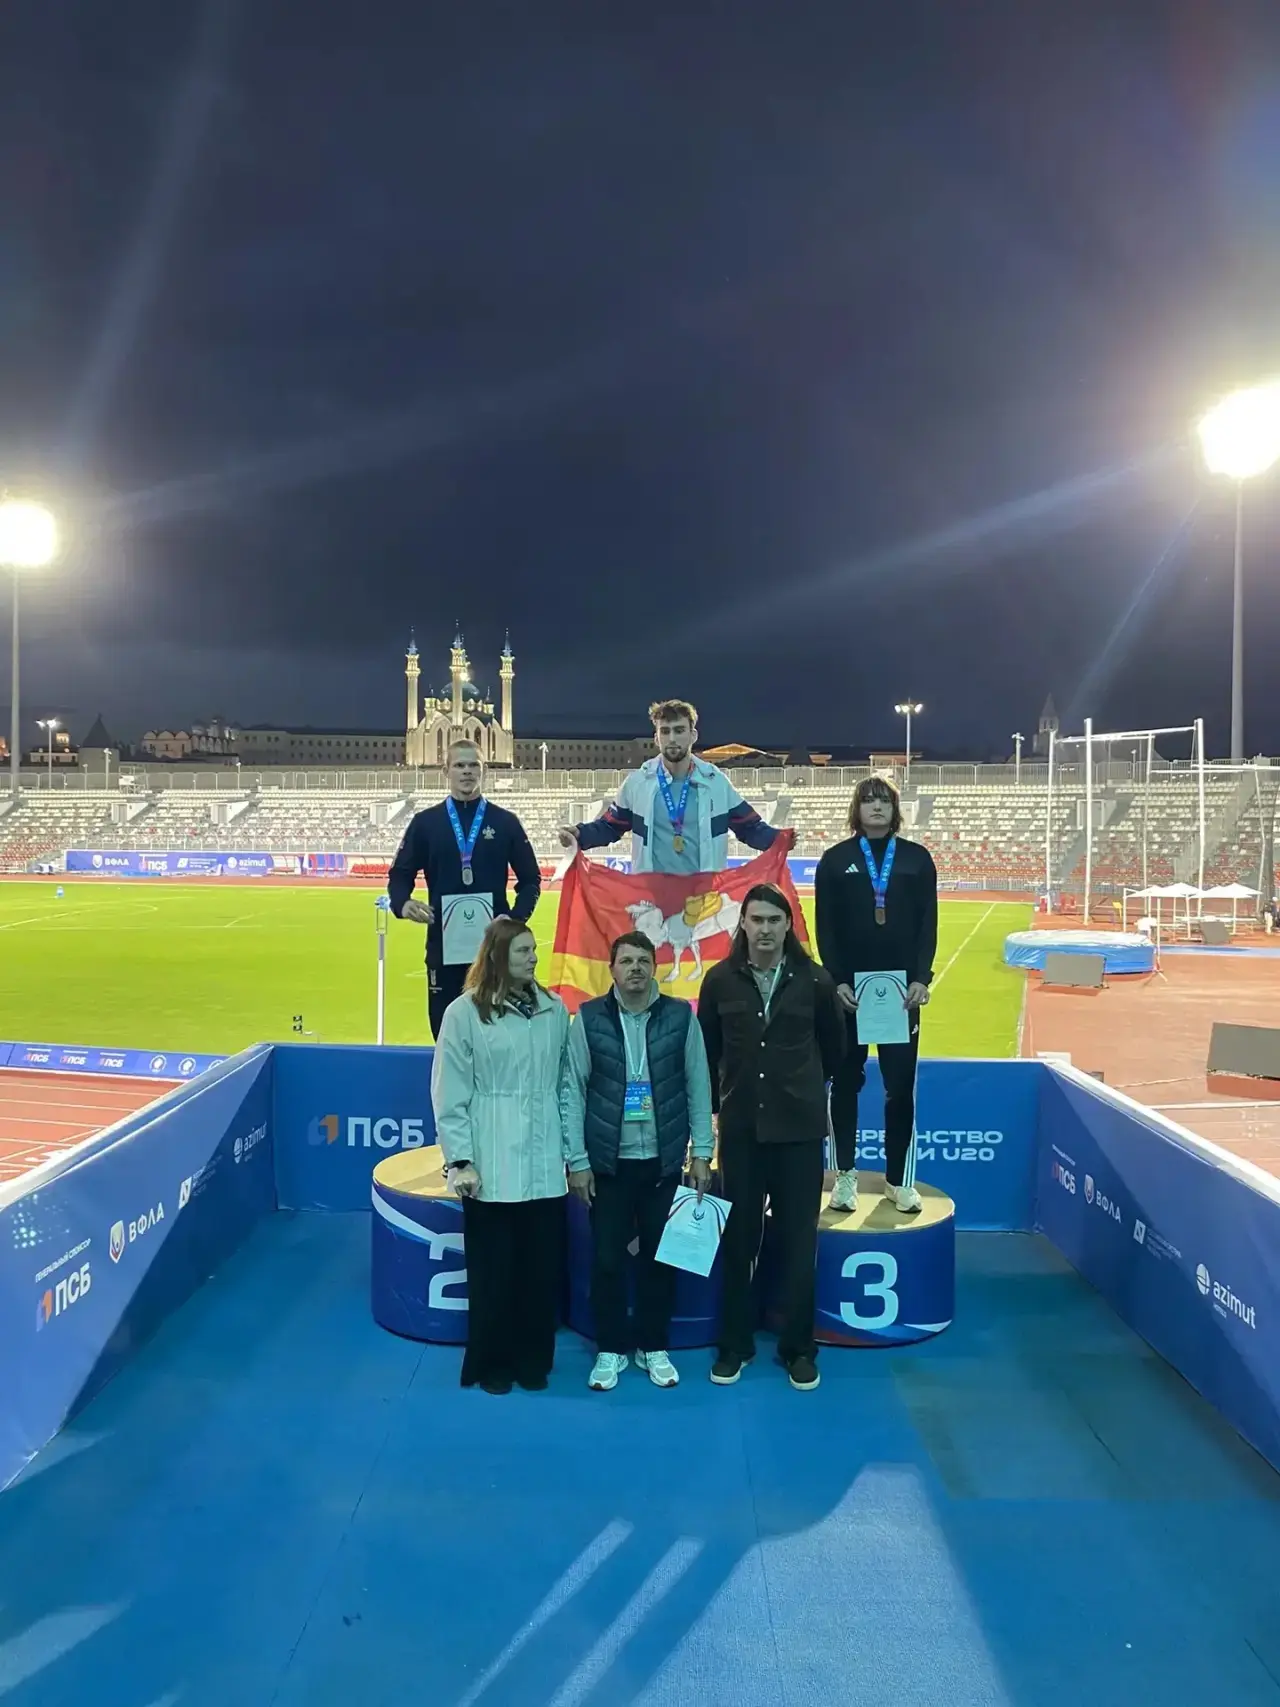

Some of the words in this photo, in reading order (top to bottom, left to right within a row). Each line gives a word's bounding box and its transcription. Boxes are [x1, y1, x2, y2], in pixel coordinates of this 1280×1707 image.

[147, 859, 168, 871] ПСБ
[238, 857, 267, 867] azimut
[30, 1054, 50, 1063] ПСБ
[67, 1056, 87, 1066] ПСБ
[104, 1058, 124, 1068] ПСБ
[243, 1120, 268, 1152] azimut
[347, 1116, 425, 1149] ПСБ
[942, 1146, 995, 1161] U20
[1058, 1164, 1077, 1195] ПСБ
[1096, 1190, 1123, 1224] ВФЛА
[128, 1202, 165, 1244] ВФЛА
[55, 1261, 91, 1317] ПСБ
[840, 1251, 899, 1330] 3
[1213, 1280, 1256, 1330] azimut
